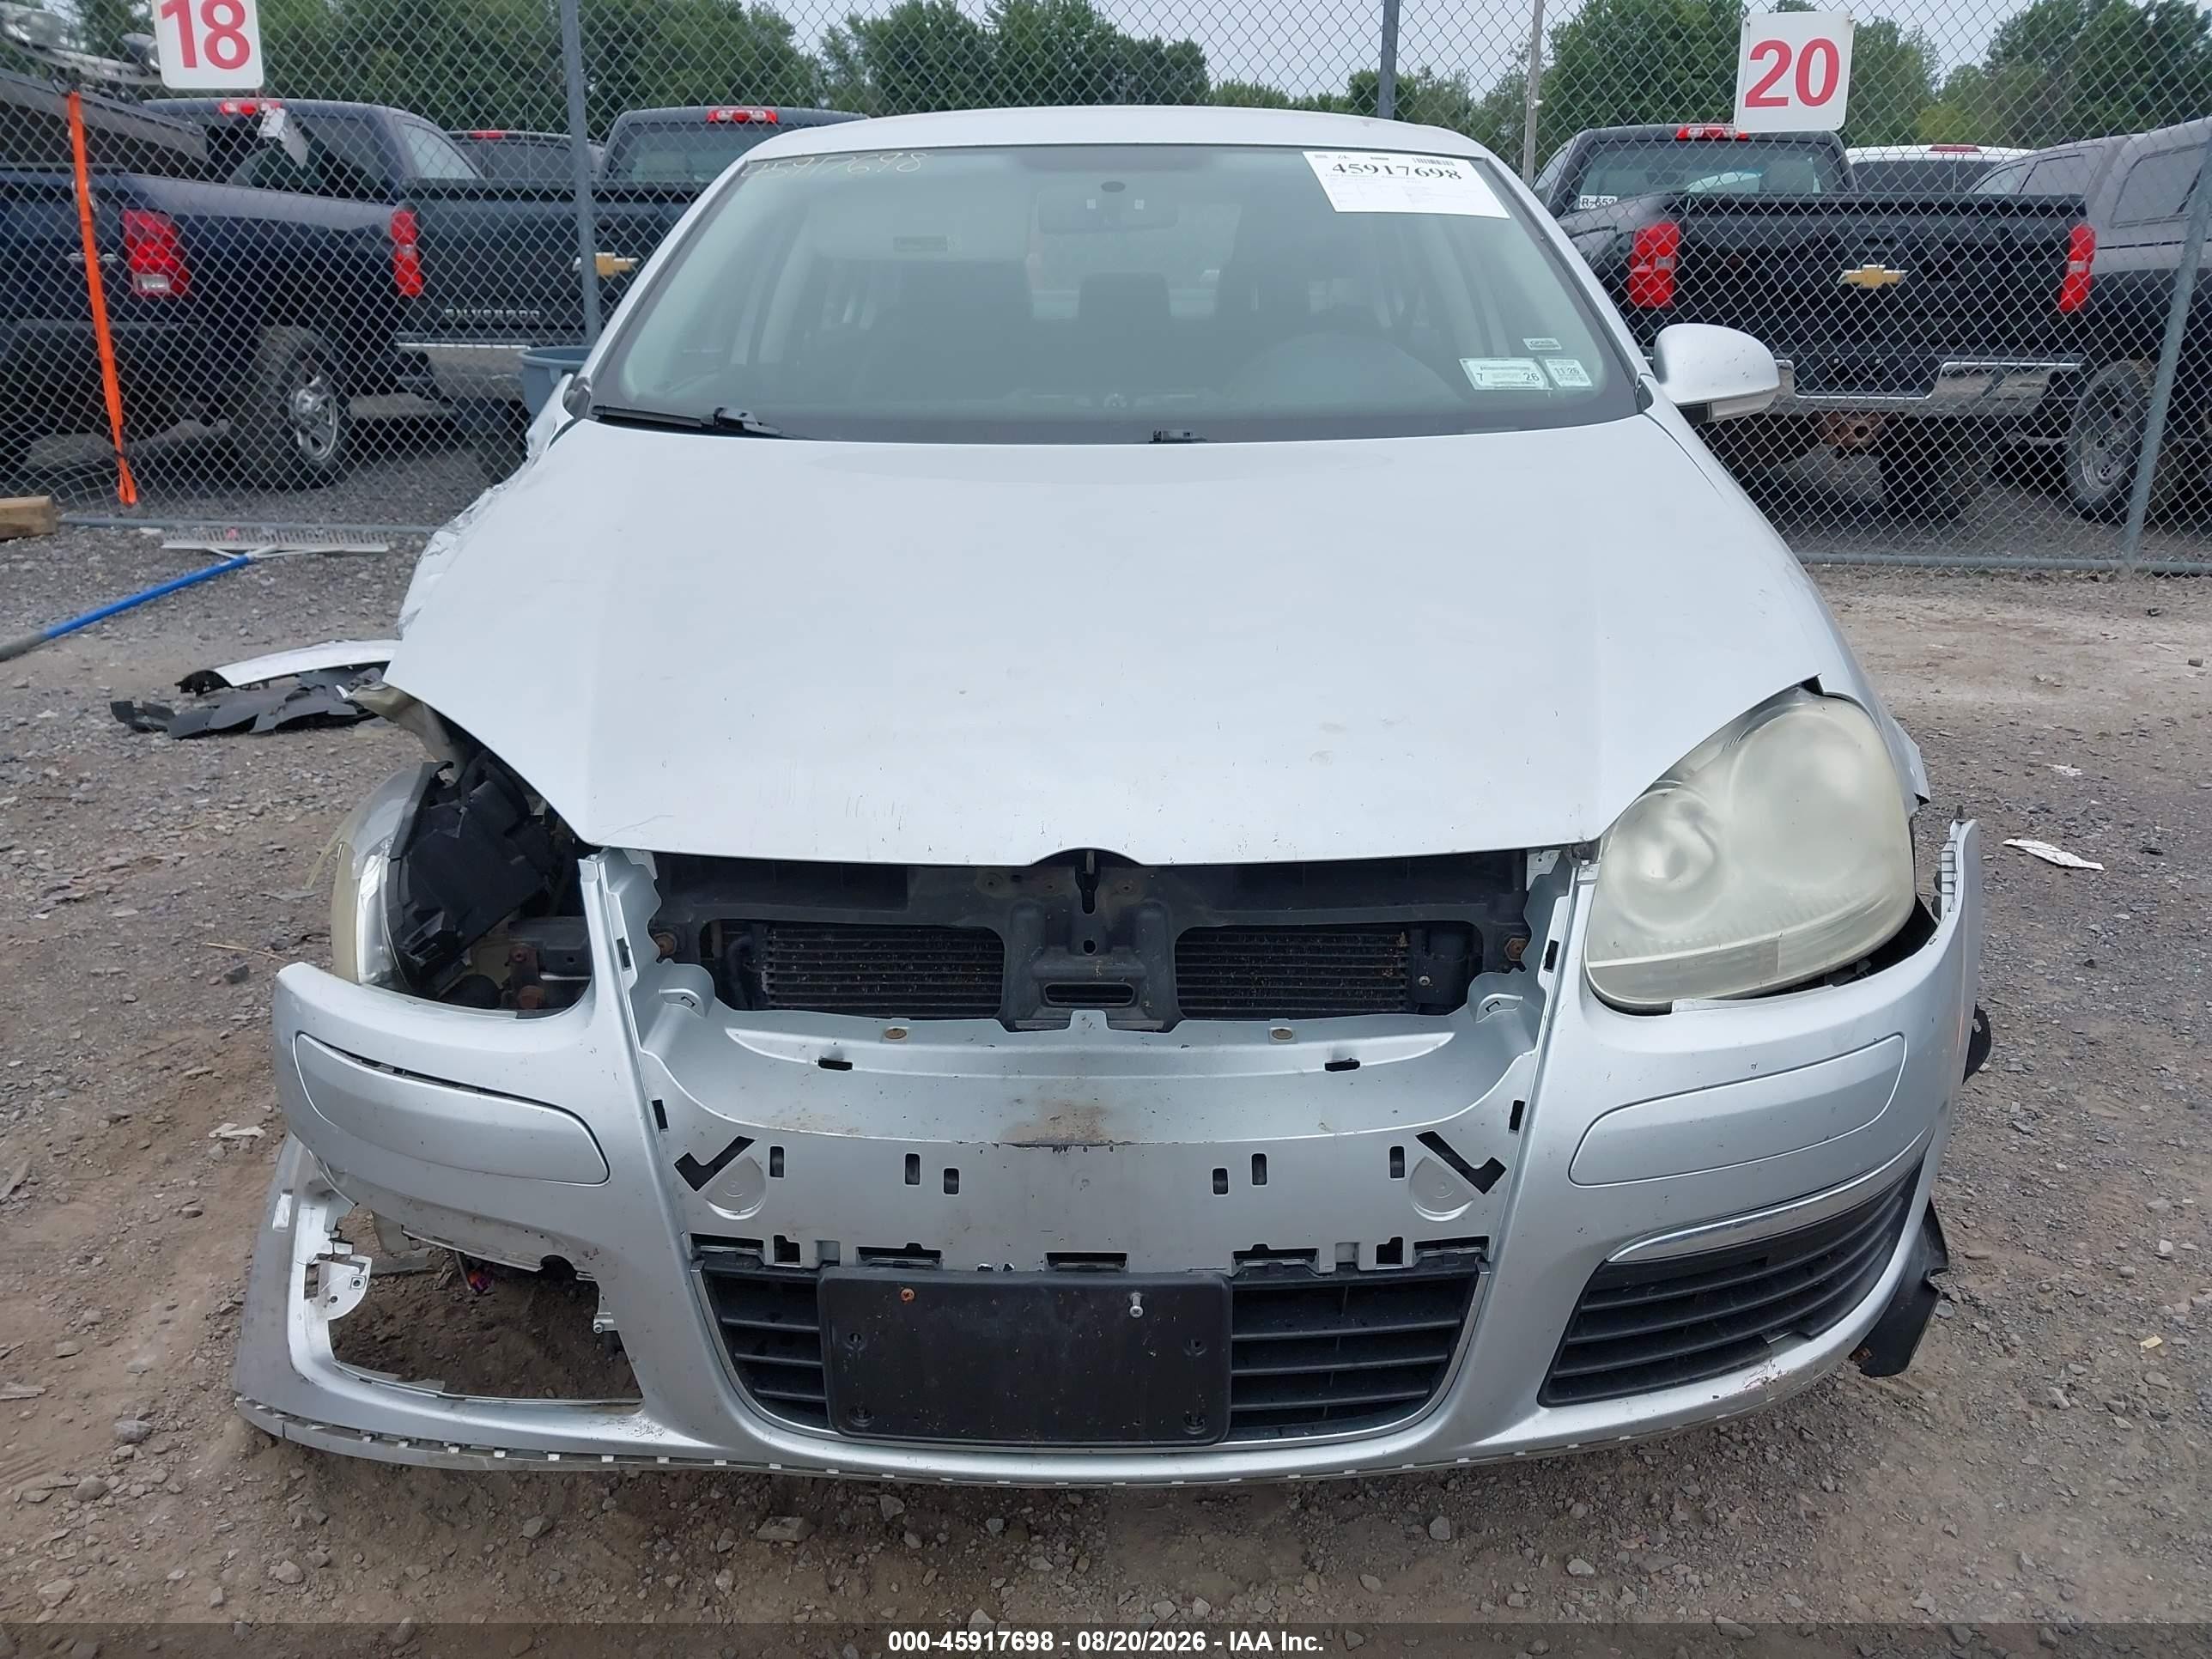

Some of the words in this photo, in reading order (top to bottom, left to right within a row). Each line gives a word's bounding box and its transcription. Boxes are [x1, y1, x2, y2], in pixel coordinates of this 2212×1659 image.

[161, 0, 251, 70] 18
[1745, 38, 1840, 107] 20
[1332, 163, 1462, 179] 45917698
[1476, 373, 1484, 381] 7
[1523, 372, 1540, 381] 26
